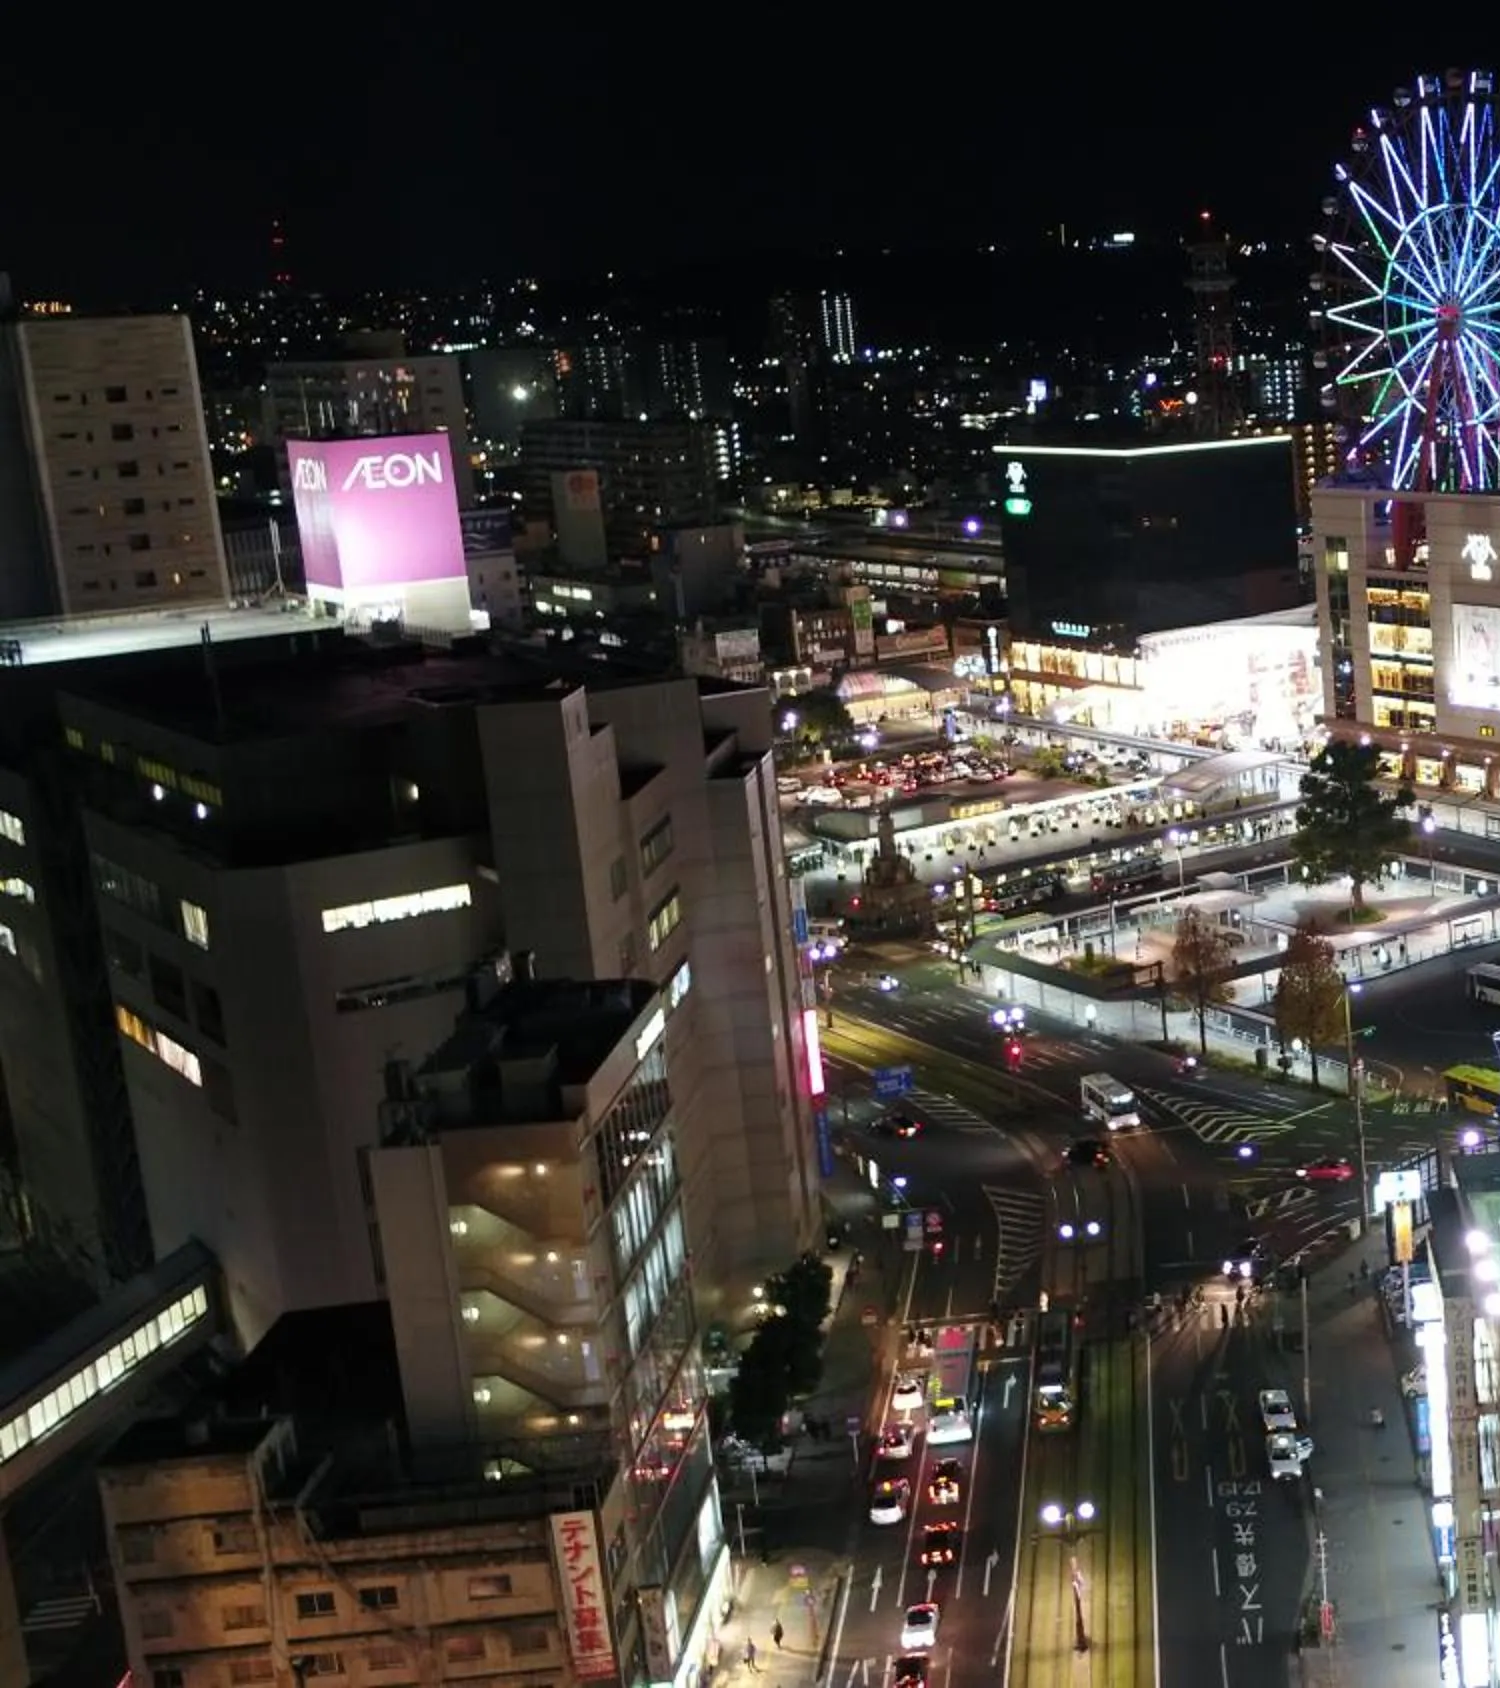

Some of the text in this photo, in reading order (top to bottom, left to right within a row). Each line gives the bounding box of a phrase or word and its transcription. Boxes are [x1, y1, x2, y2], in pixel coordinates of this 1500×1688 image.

[559, 1519, 608, 1652] テナント募集
